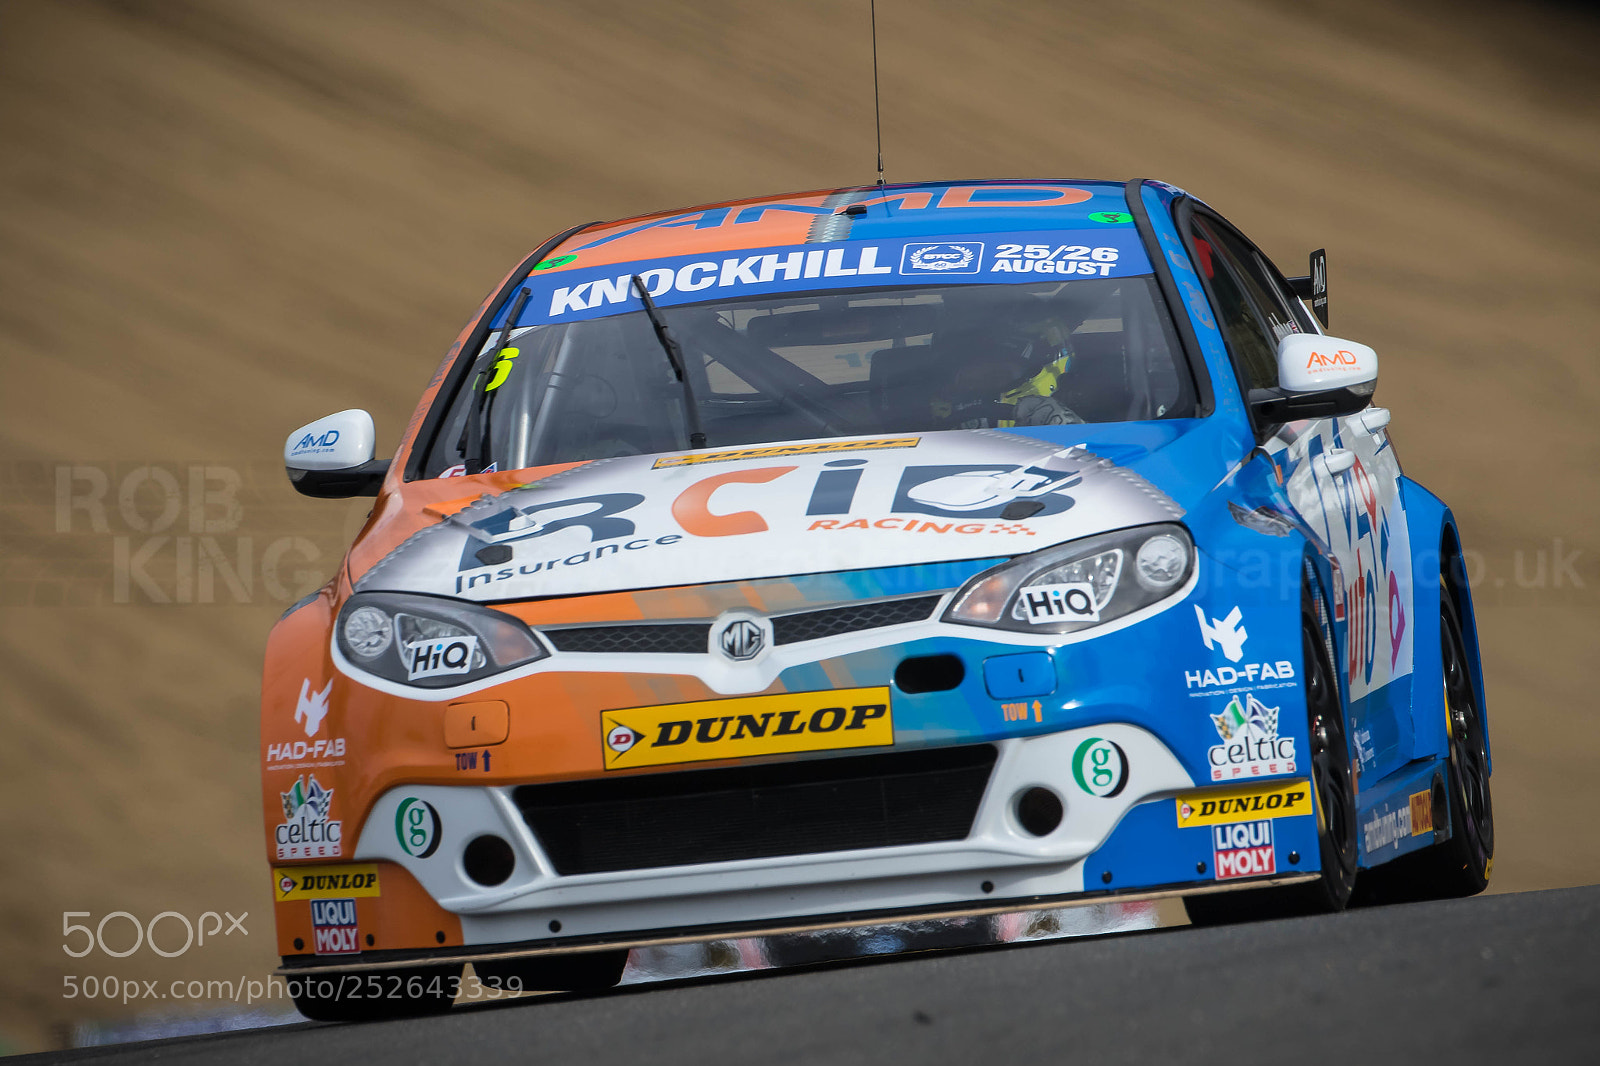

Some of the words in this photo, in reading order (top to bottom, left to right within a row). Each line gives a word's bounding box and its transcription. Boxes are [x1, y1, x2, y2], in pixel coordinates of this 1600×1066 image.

[993, 243, 1119, 263] 25/26
[990, 258, 1117, 277] AUGUST
[548, 246, 893, 317] KNOCKHILL
[1307, 350, 1357, 369] AMD
[293, 430, 339, 451] AMD
[807, 518, 985, 535] RACING
[454, 533, 684, 595] Insurance
[1026, 588, 1096, 617] HiQ
[722, 619, 761, 657] MG
[411, 641, 469, 674] HiQ
[1184, 660, 1296, 689] HAD-FAB
[1001, 703, 1028, 722] TOW
[651, 704, 887, 748] DUNLOP
[267, 738, 346, 762] HAD-FAB
[455, 752, 478, 771] TOW
[1213, 762, 1296, 780] SPEED
[1198, 792, 1305, 817] DUNLOP
[1215, 822, 1271, 850] LIQUI
[278, 845, 341, 858] SPEED
[1218, 848, 1272, 877] MOLY
[300, 872, 377, 891] DUNLOP
[313, 900, 356, 925] LIQUI
[316, 927, 358, 952] MOLY
